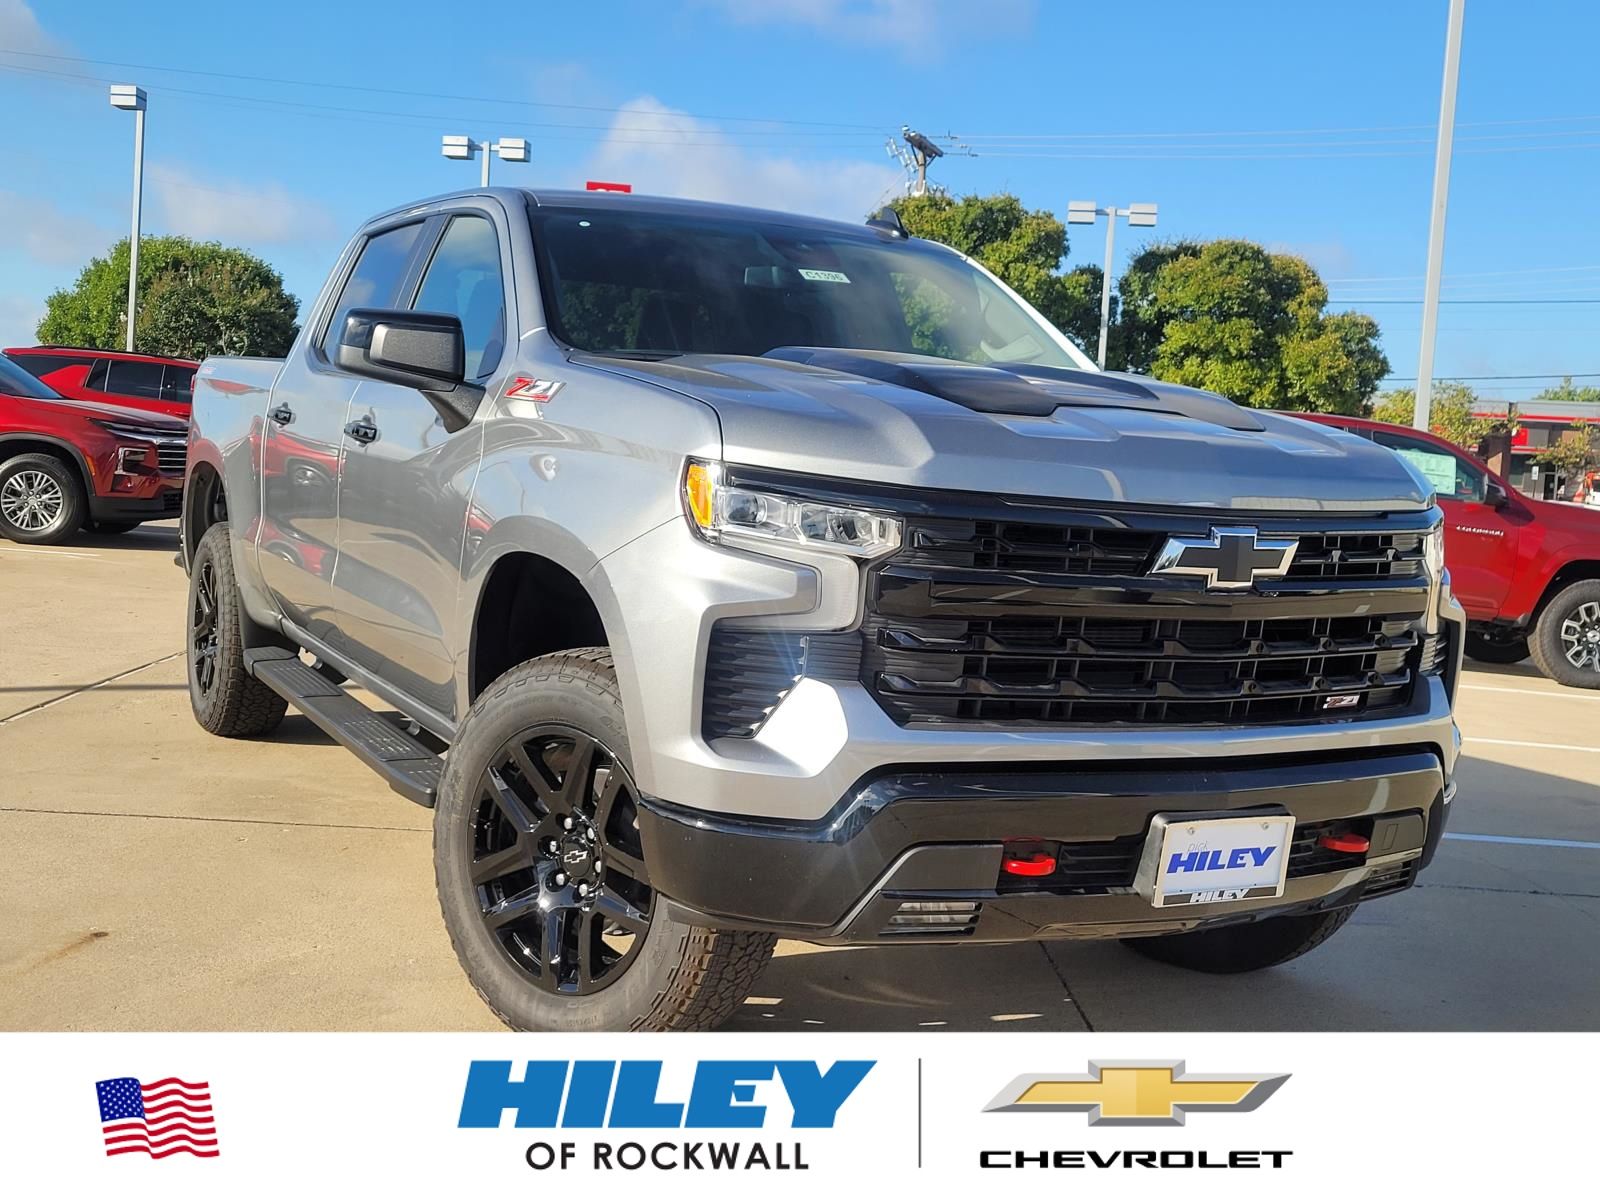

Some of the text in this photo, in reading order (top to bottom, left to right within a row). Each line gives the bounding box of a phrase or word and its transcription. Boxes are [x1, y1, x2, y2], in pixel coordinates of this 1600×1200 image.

[504, 376, 567, 403] Z71
[1166, 846, 1277, 874] HILEY
[1189, 888, 1250, 903] HILEY
